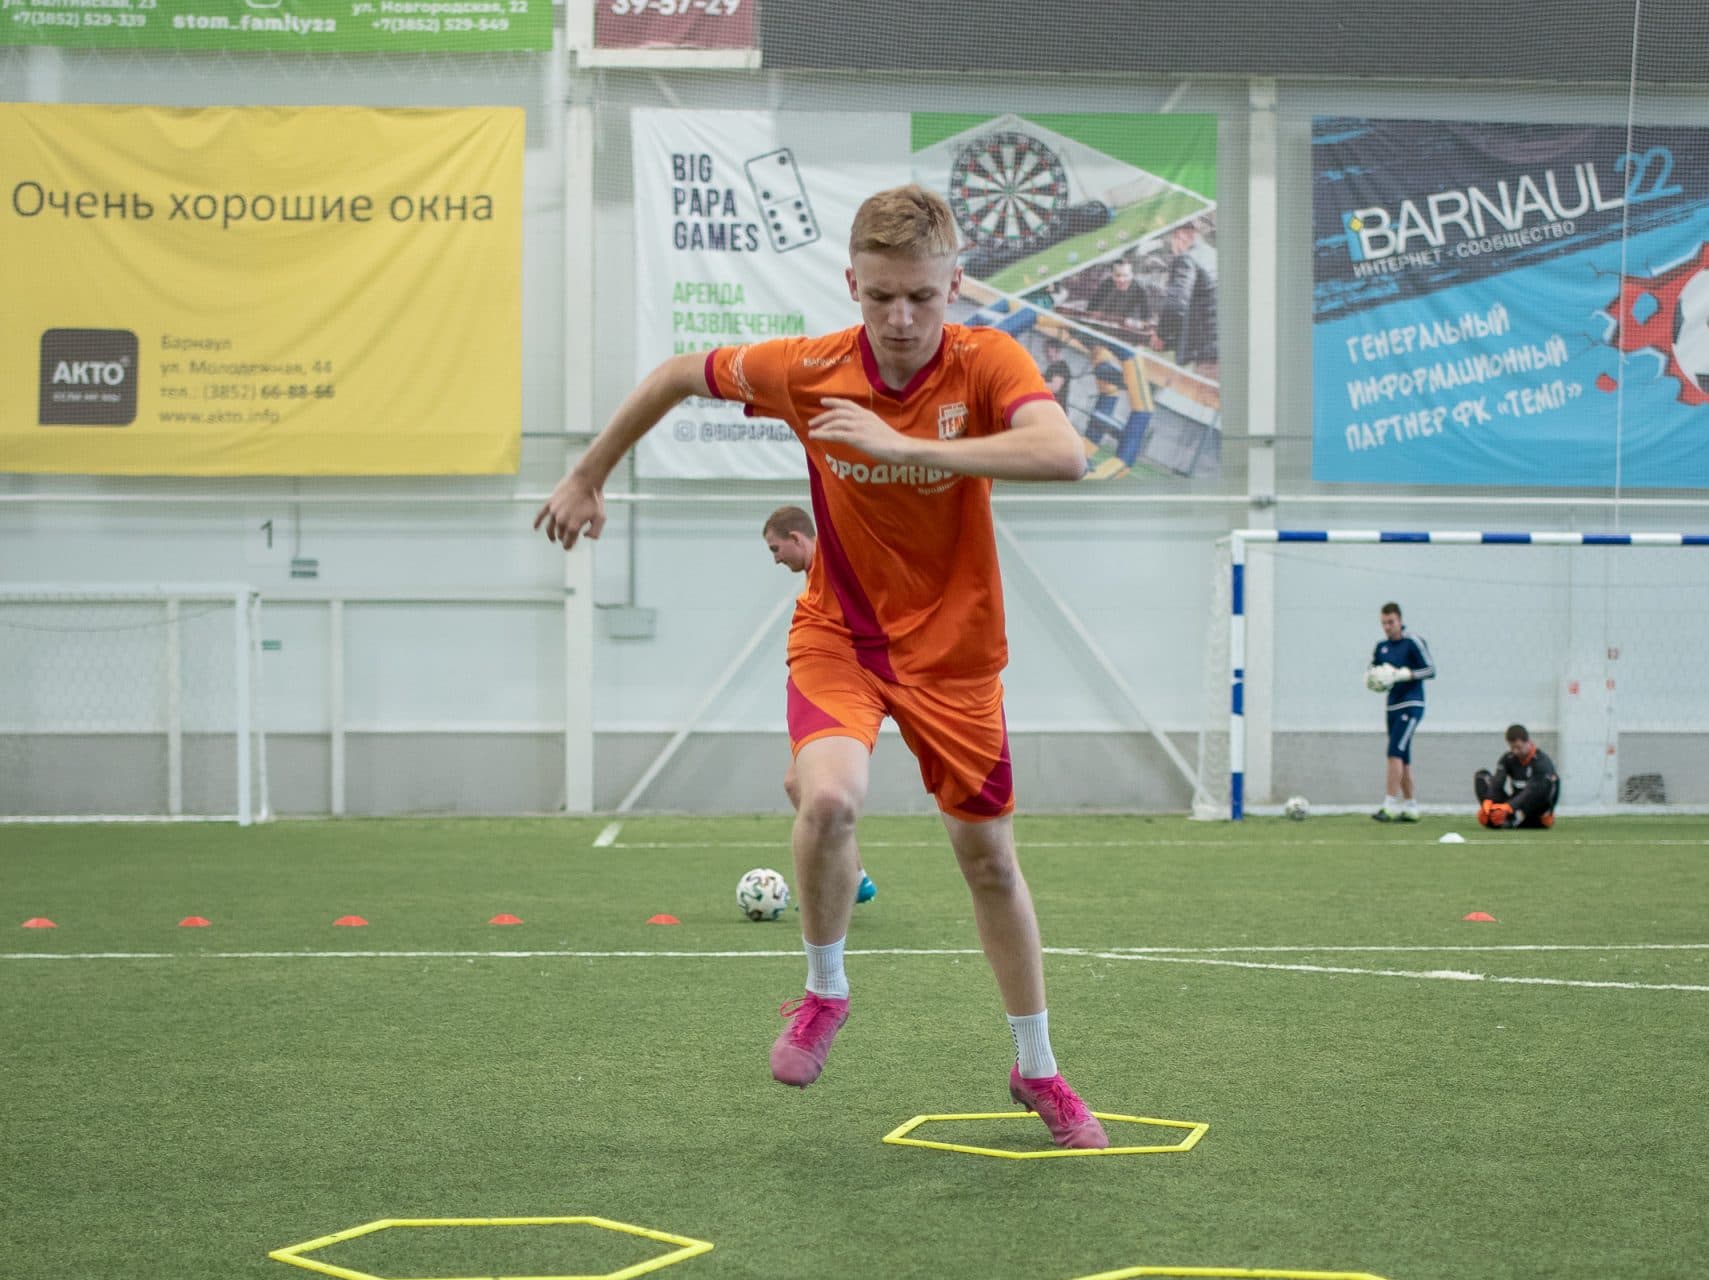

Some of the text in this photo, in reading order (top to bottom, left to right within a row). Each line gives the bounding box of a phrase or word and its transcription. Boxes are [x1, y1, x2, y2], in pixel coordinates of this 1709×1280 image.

[351, 0, 529, 16] ул. Новгородская, 22
[672, 153, 712, 183] BIG
[12, 181, 494, 229] Очень хорошие окна
[673, 187, 737, 217] PAPA
[674, 221, 759, 252] GAMES
[1352, 249, 1442, 278] ИНТЕРНЕТ
[1456, 221, 1576, 258] СООБЩЕСТВО
[672, 281, 745, 306] АРЕНДА
[672, 309, 805, 335] РАЗВЛЕЧЕНИЙ
[1346, 302, 1510, 364] ГЕНЕРАЛЬНЫЙ
[1346, 334, 1569, 411] ИНФОРМАЦИОННЫЙ
[1345, 379, 1582, 452] ПАРТНЕР ФК «ТЕМП»
[260, 519, 274, 550] 1
